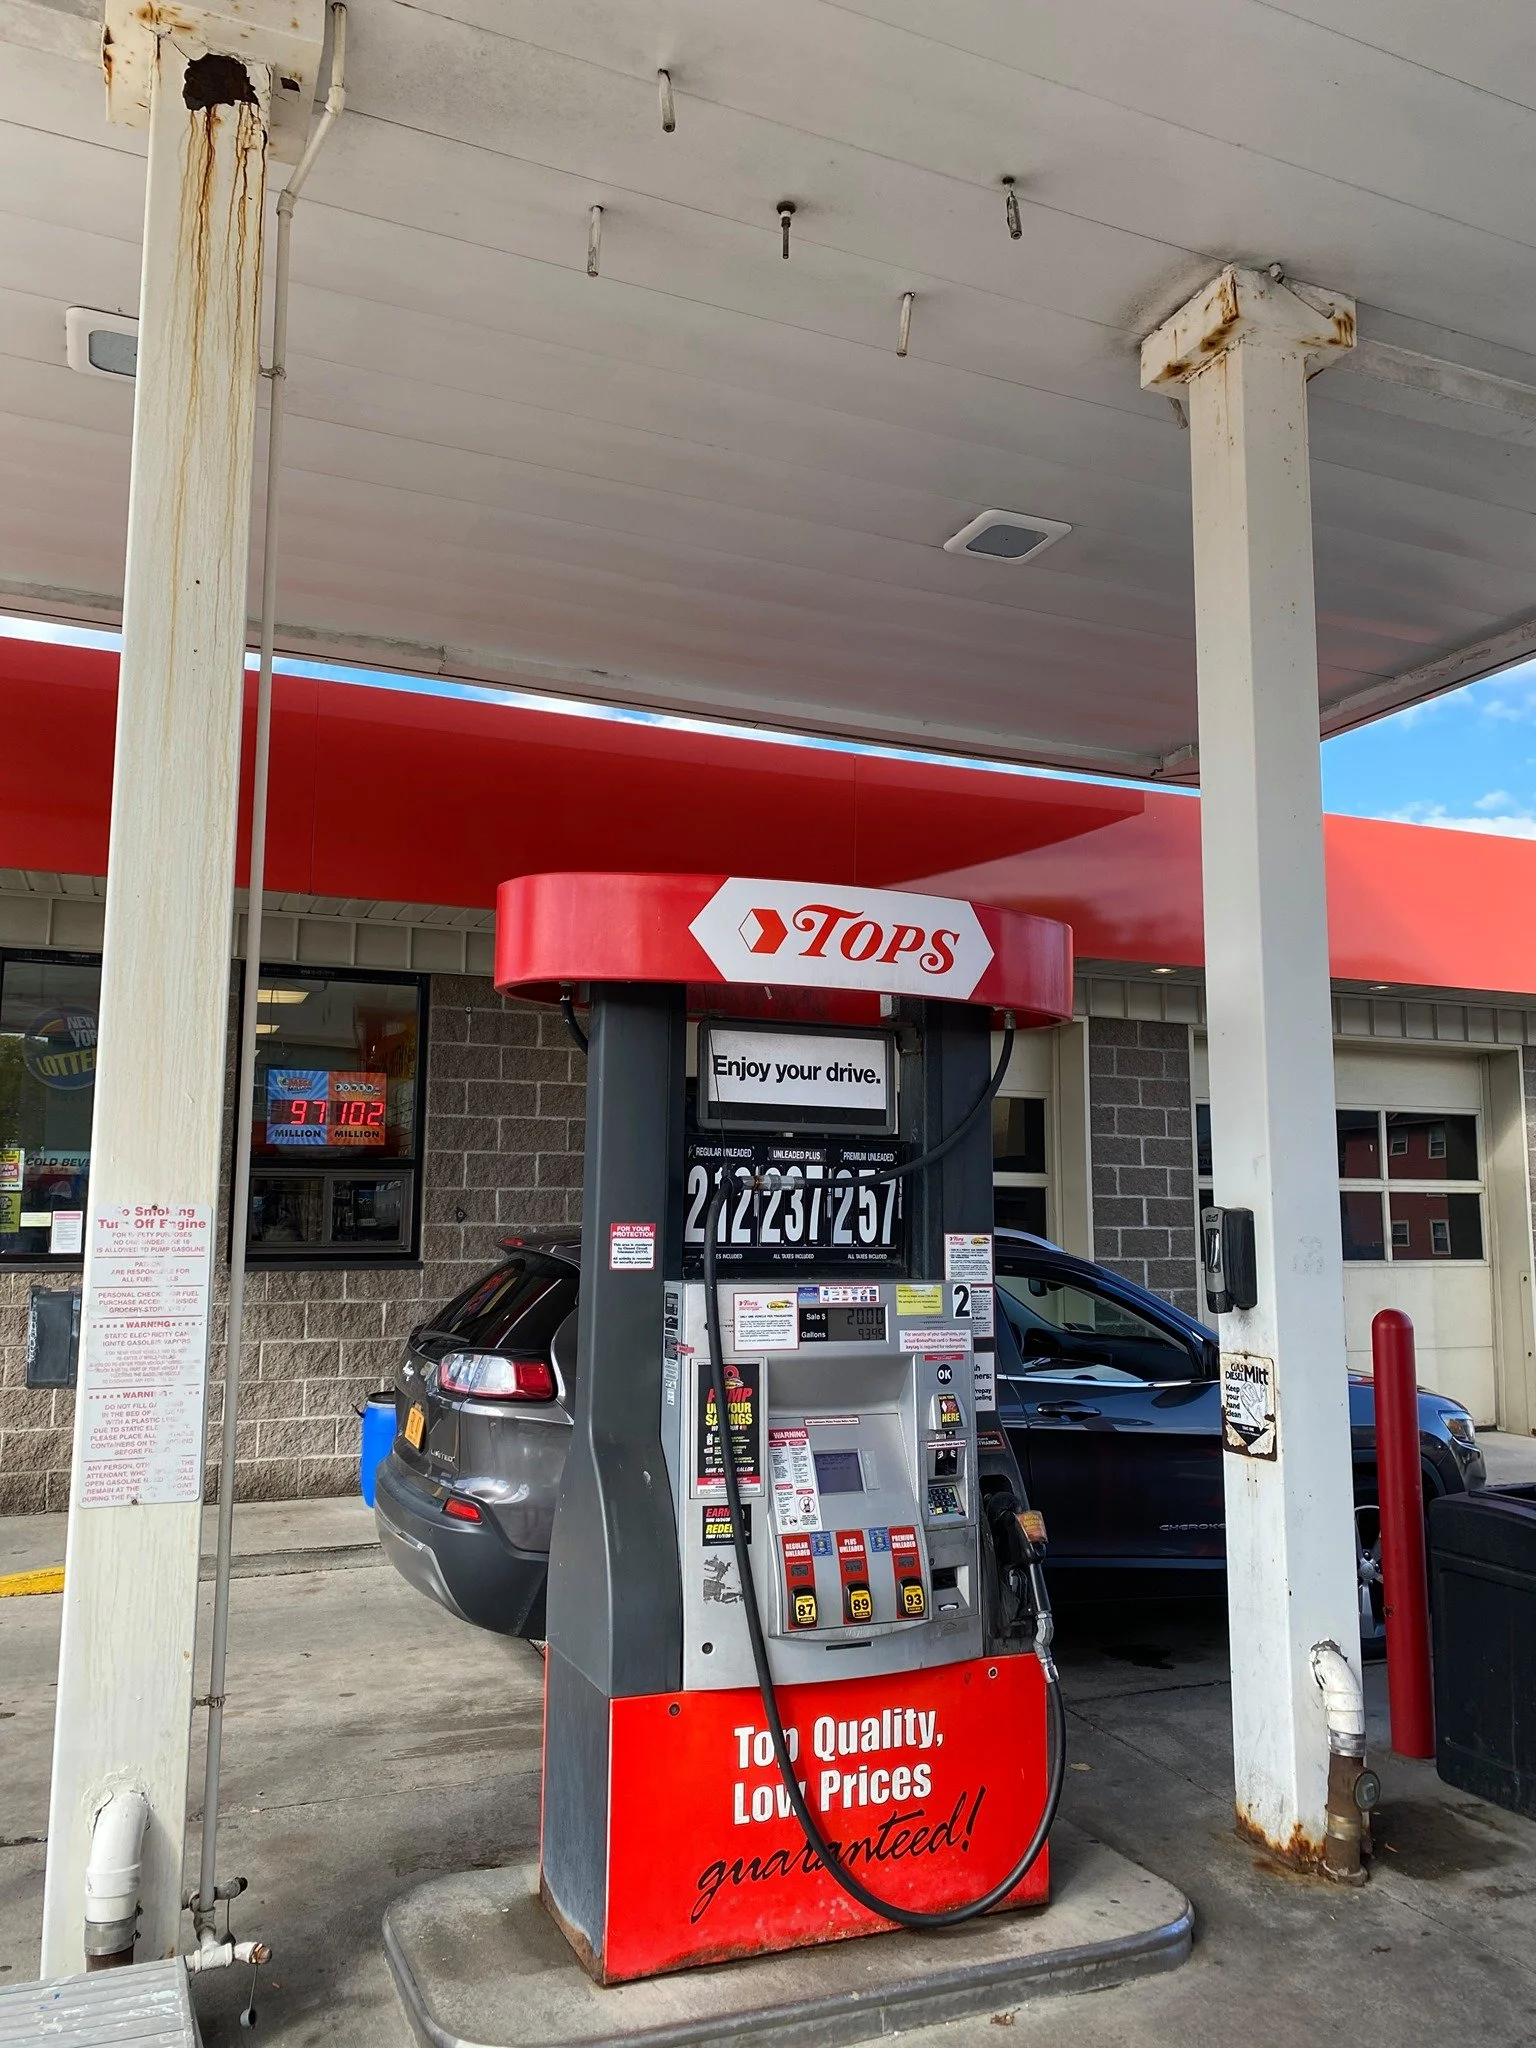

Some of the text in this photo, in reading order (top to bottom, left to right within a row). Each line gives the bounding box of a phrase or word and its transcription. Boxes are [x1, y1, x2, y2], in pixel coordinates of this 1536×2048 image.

[792, 904, 960, 974] TOPS
[67, 1016, 95, 1029] NEW
[36, 1047, 97, 1076] LOTTE
[713, 1055, 882, 1084] Enjoy your drive.
[291, 1100, 327, 1124] 97
[340, 1102, 384, 1125] 102
[274, 1129, 321, 1138] MILLION
[334, 1130, 380, 1138] MILLION
[695, 1147, 752, 1157] REGULAR UNLEADED
[773, 1150, 821, 1160] UNLEADED PLUS
[843, 1152, 895, 1161] PREMIUM UNLEADED
[26, 1157, 57, 1167] COLD
[135, 1206, 195, 1218] Smong
[98, 1219, 129, 1229] Tur
[134, 1219, 155, 1229] Off
[954, 1285, 970, 1317] 2
[822, 1313, 826, 1321] $
[801, 1331, 826, 1339] Gallons
[938, 1370, 951, 1380] OK
[1225, 1371, 1244, 1381] DIESEL
[1231, 1363, 1268, 1385] GAS Mitt
[1225, 1384, 1240, 1393] Keep
[708, 1388, 753, 1403] PMP
[1226, 1393, 1239, 1402] your
[1226, 1401, 1240, 1409] hand
[942, 1413, 960, 1423] HERE
[1226, 1410, 1241, 1418] clean
[773, 1431, 807, 1439] WARNING
[1160, 1523, 1226, 1531] CHEROKE
[891, 1534, 914, 1542] PREMIUM
[785, 1542, 808, 1550] REGULAR
[839, 1545, 864, 1553] UNLEADED
[892, 1541, 916, 1549] UNLEADED
[785, 1549, 810, 1557] UNLEADED
[853, 1599, 869, 1611] 89
[906, 1594, 922, 1606] 93
[797, 1604, 814, 1616] 87
[733, 1708, 945, 1769] Top Quality,
[733, 1763, 932, 1826] Low Prices
[690, 1785, 987, 1925] guaranteed!
